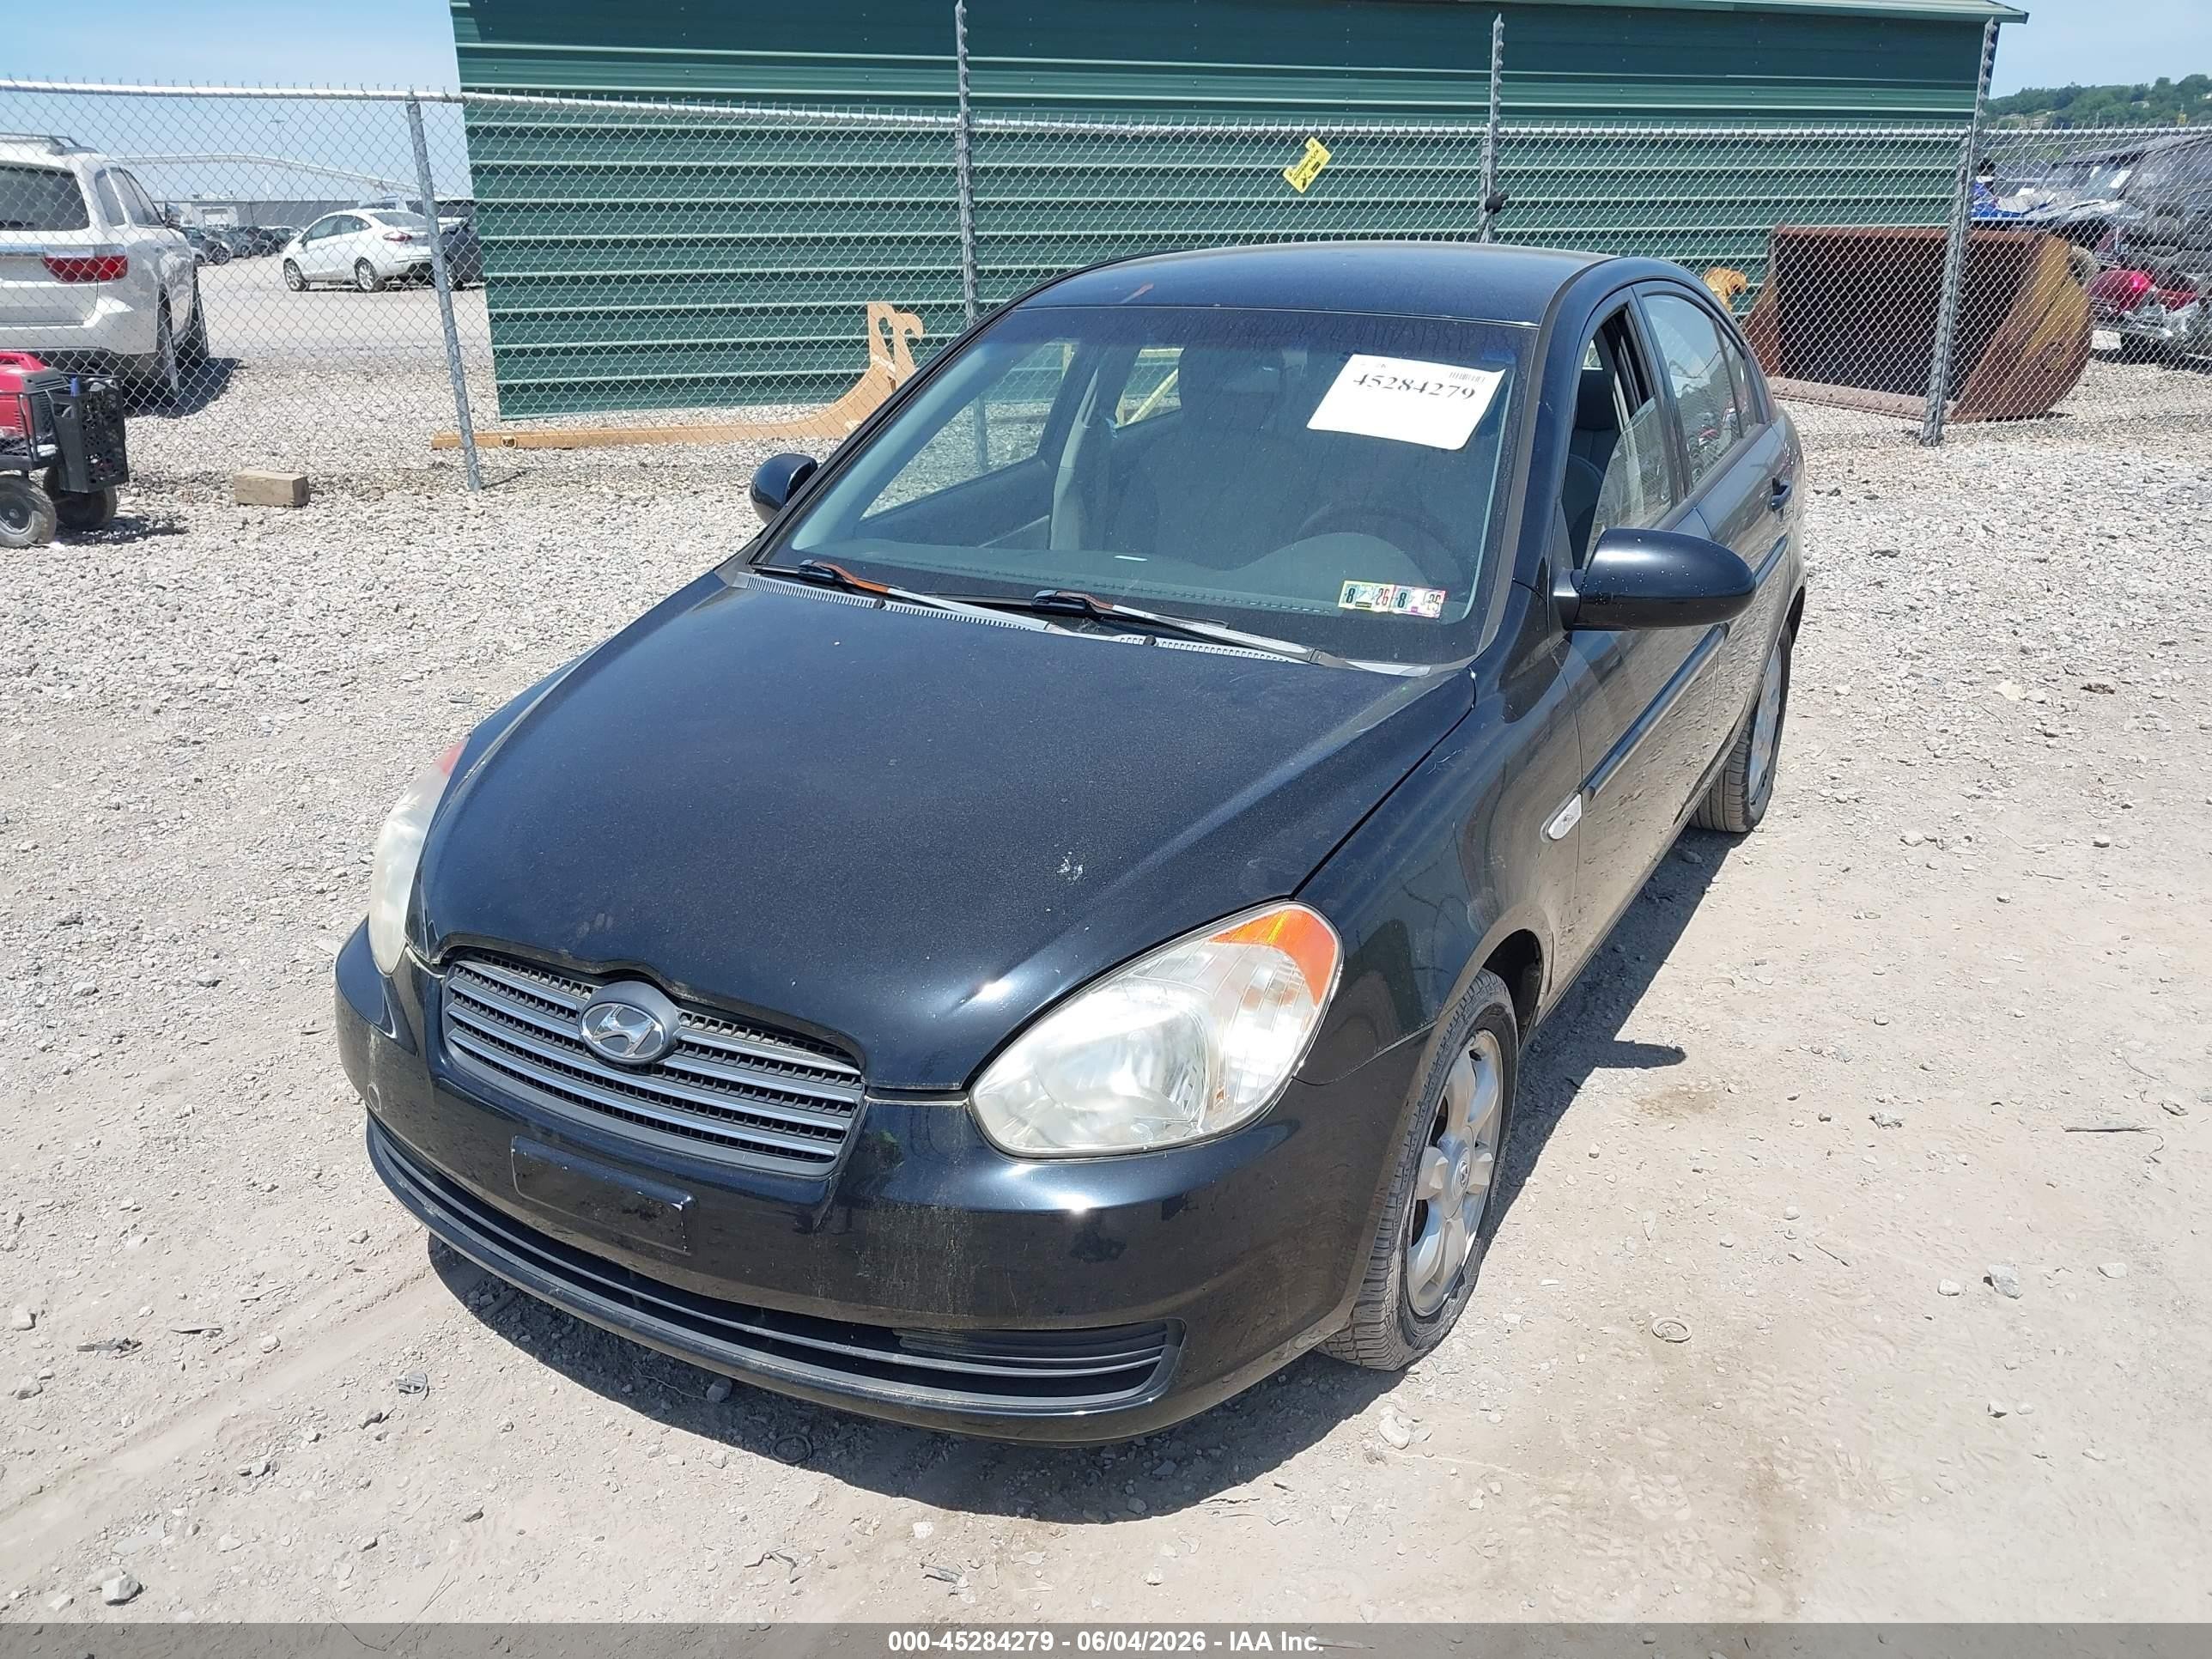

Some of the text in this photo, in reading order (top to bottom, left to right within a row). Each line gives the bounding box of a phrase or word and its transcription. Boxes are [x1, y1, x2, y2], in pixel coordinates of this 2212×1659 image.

[1353, 374, 1475, 399] 45284279
[1346, 587, 1390, 605] 8 26
[1397, 592, 1407, 608] 8
